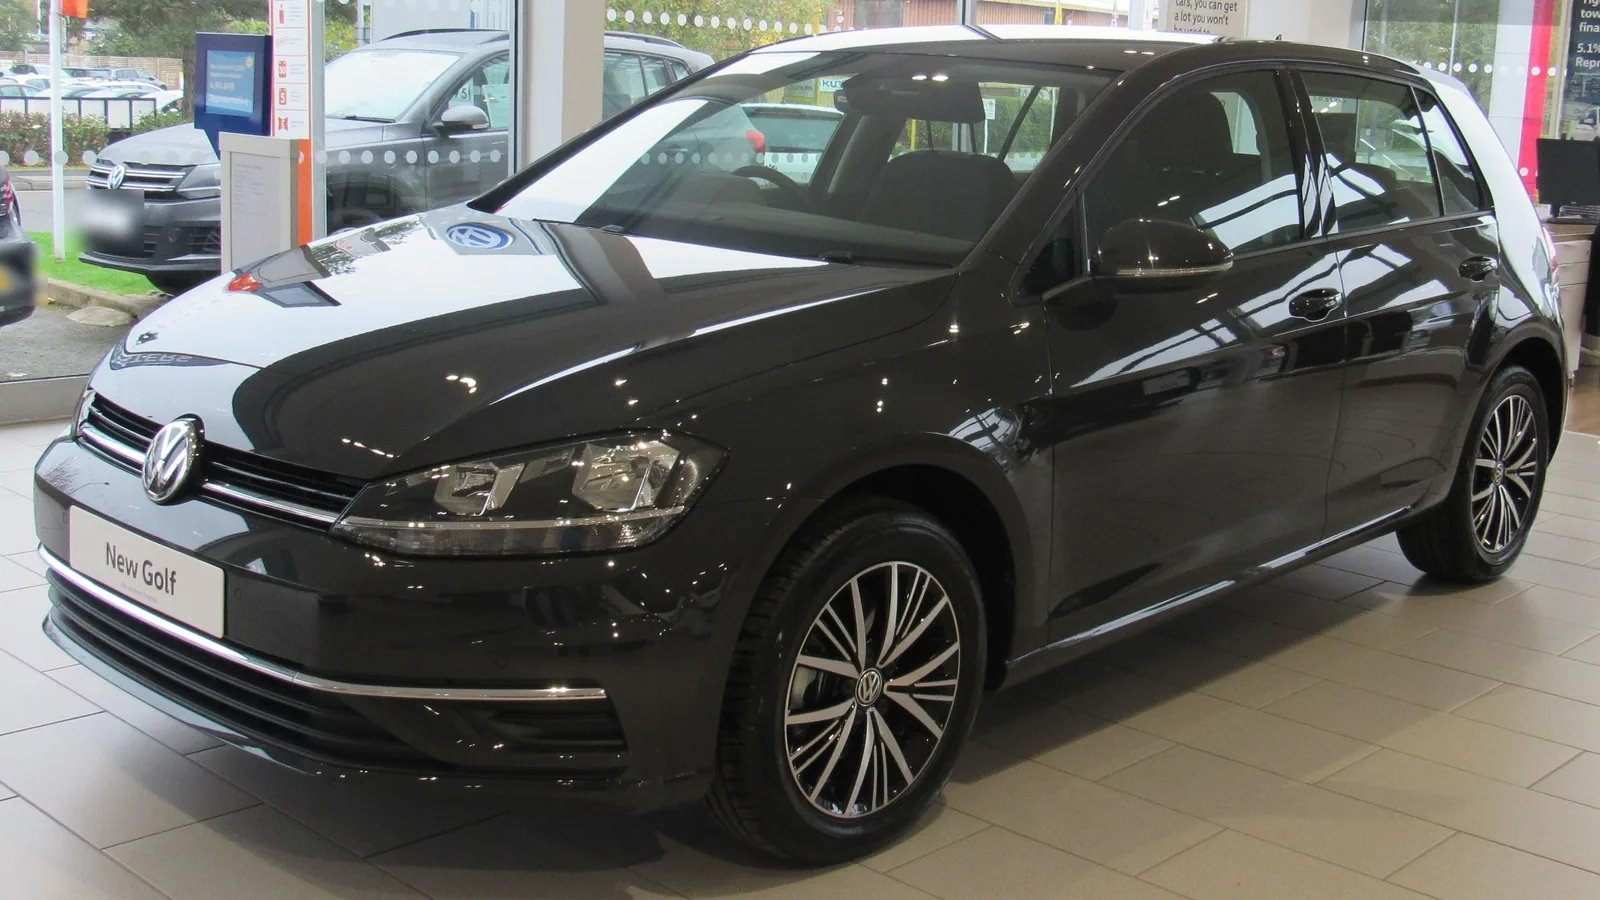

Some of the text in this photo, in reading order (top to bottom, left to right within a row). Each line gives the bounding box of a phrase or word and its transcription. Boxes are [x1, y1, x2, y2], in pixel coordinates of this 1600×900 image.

[1176, 0, 1238, 13] cars, you can get
[1181, 11, 1191, 22] lot
[1193, 15, 1206, 25] you
[1207, 15, 1229, 25] won't
[106, 542, 138, 579] New
[142, 560, 176, 596] Golf
